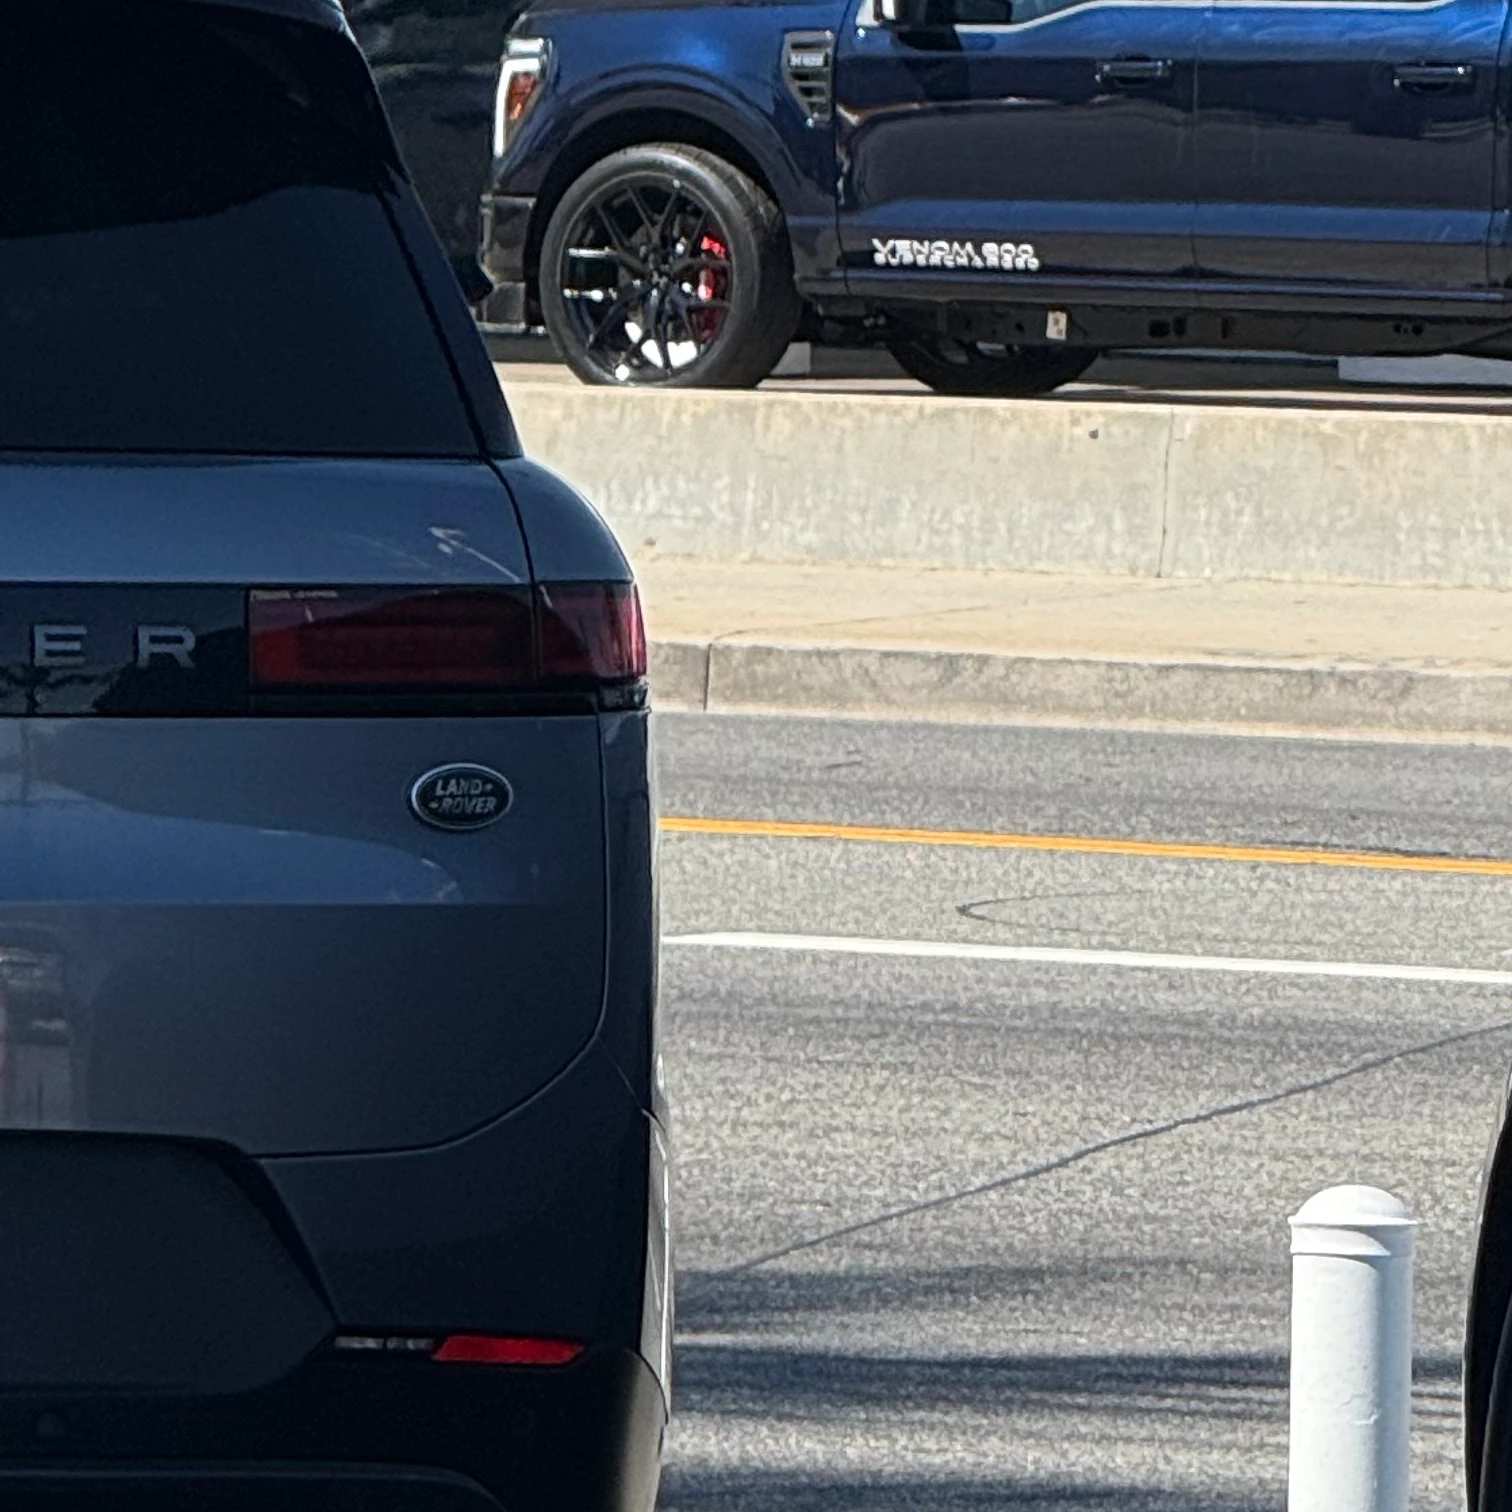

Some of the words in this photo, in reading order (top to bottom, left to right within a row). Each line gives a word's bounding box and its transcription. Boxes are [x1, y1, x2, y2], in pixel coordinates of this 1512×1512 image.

[872, 238, 976, 257] VENOM
[435, 779, 482, 796] LAND
[438, 796, 497, 813] ROVER
